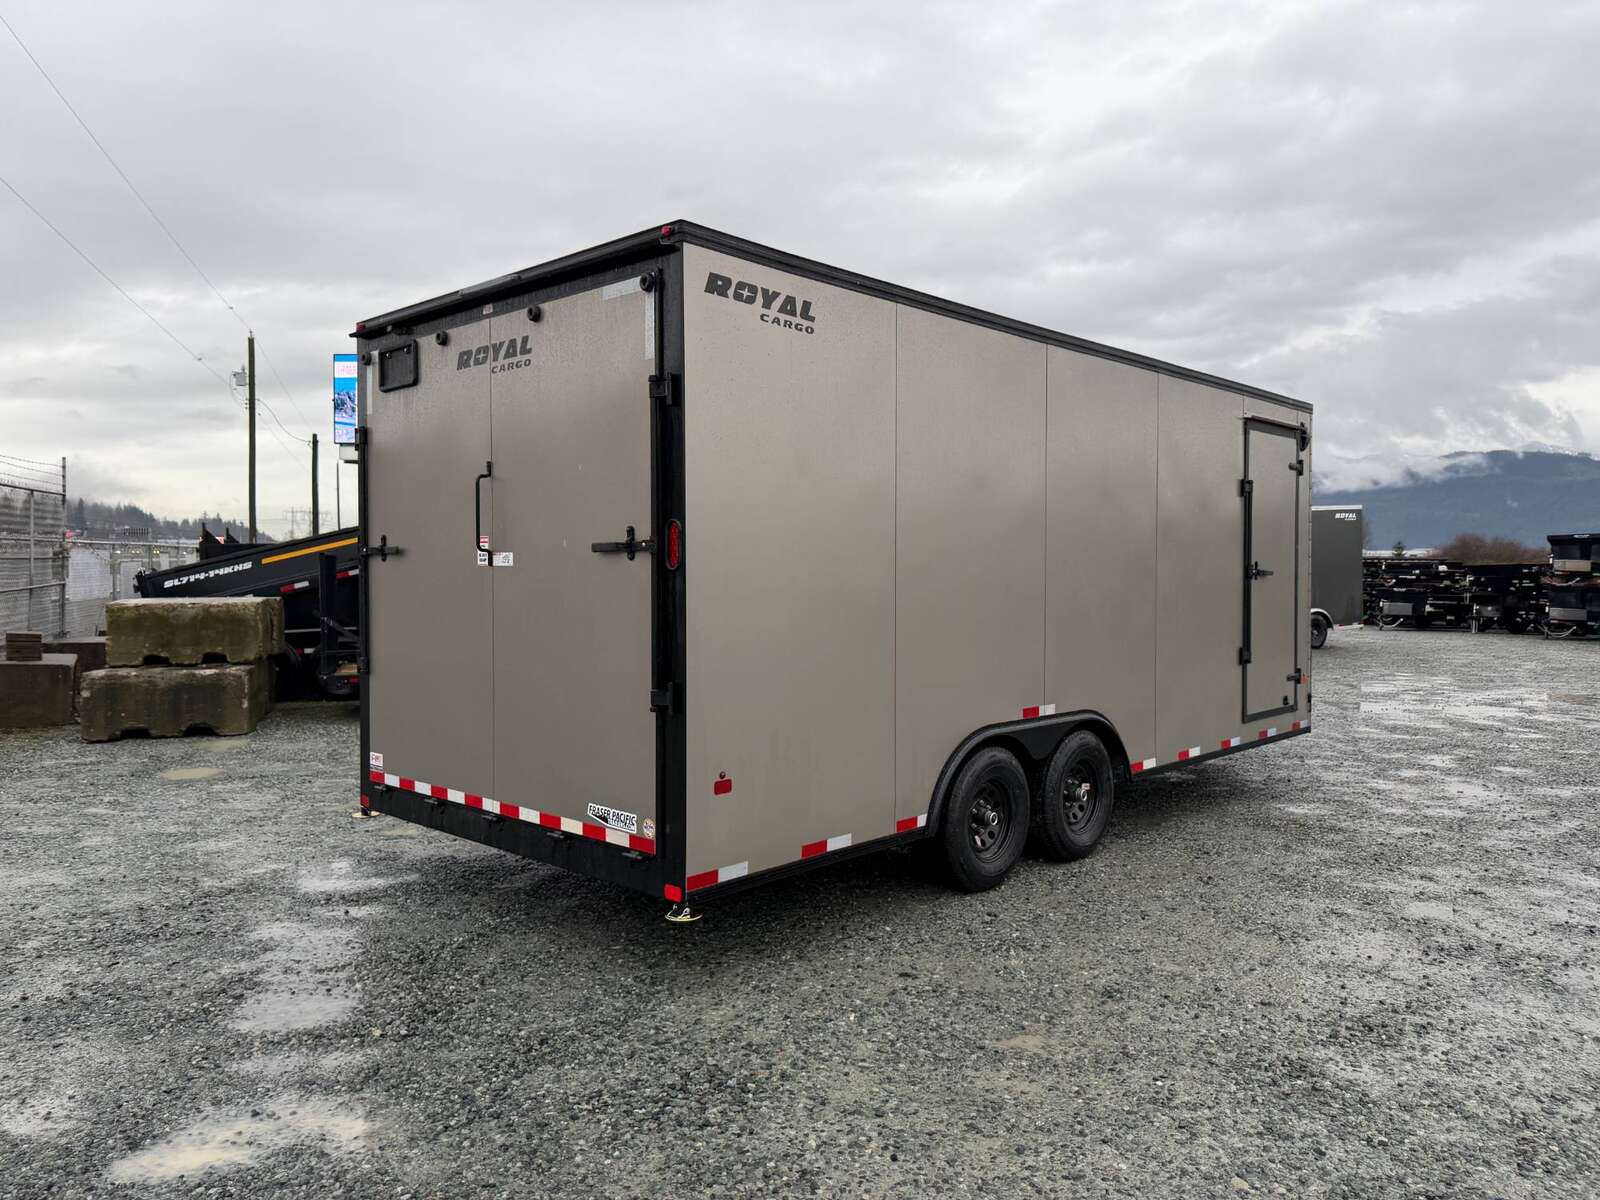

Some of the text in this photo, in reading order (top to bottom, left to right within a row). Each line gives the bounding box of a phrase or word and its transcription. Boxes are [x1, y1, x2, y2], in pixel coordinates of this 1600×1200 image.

[704, 272, 816, 323] ROYAL
[760, 313, 815, 334] CARGO
[456, 335, 532, 371] ROYAL
[491, 359, 532, 374] CARGO
[589, 804, 611, 819] FRASER
[611, 811, 635, 826] PACIFIC
